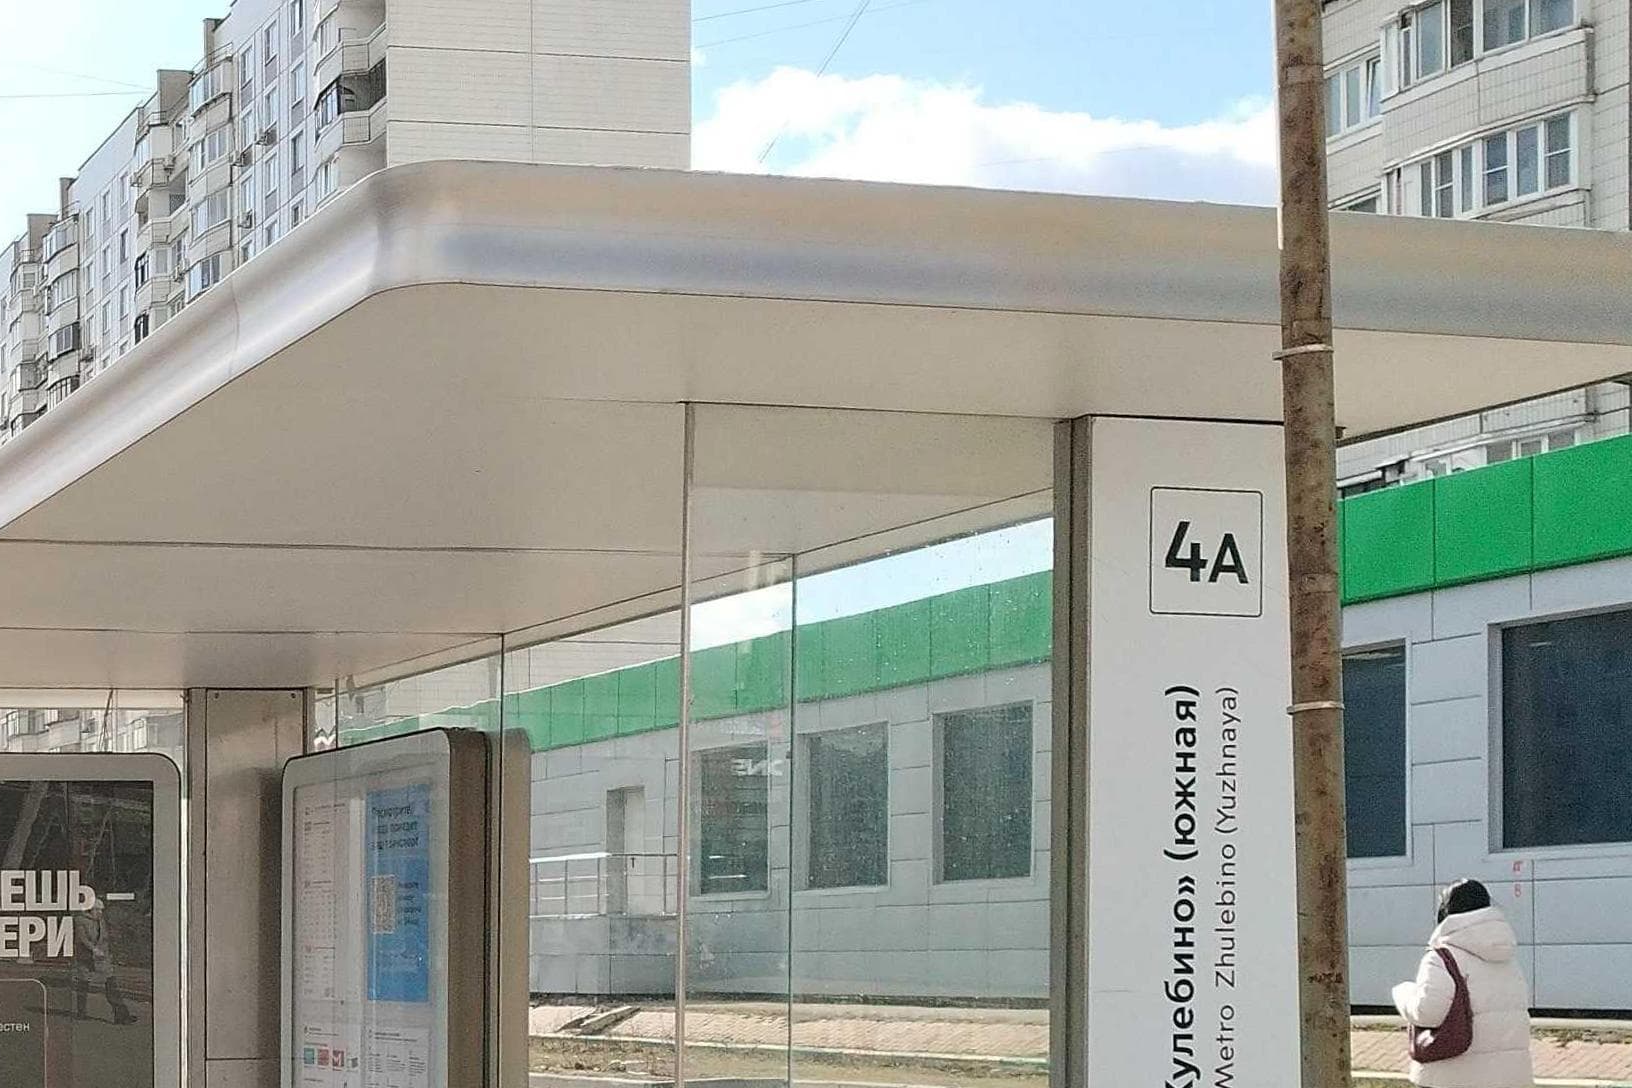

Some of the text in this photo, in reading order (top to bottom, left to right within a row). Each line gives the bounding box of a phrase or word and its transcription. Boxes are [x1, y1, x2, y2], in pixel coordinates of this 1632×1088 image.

[1165, 520, 1249, 584] 4А
[1163, 685, 1200, 861] (южная)
[1214, 687, 1241, 834] (Yuzhnaya)
[1214, 843, 1237, 988] Zhulebino
